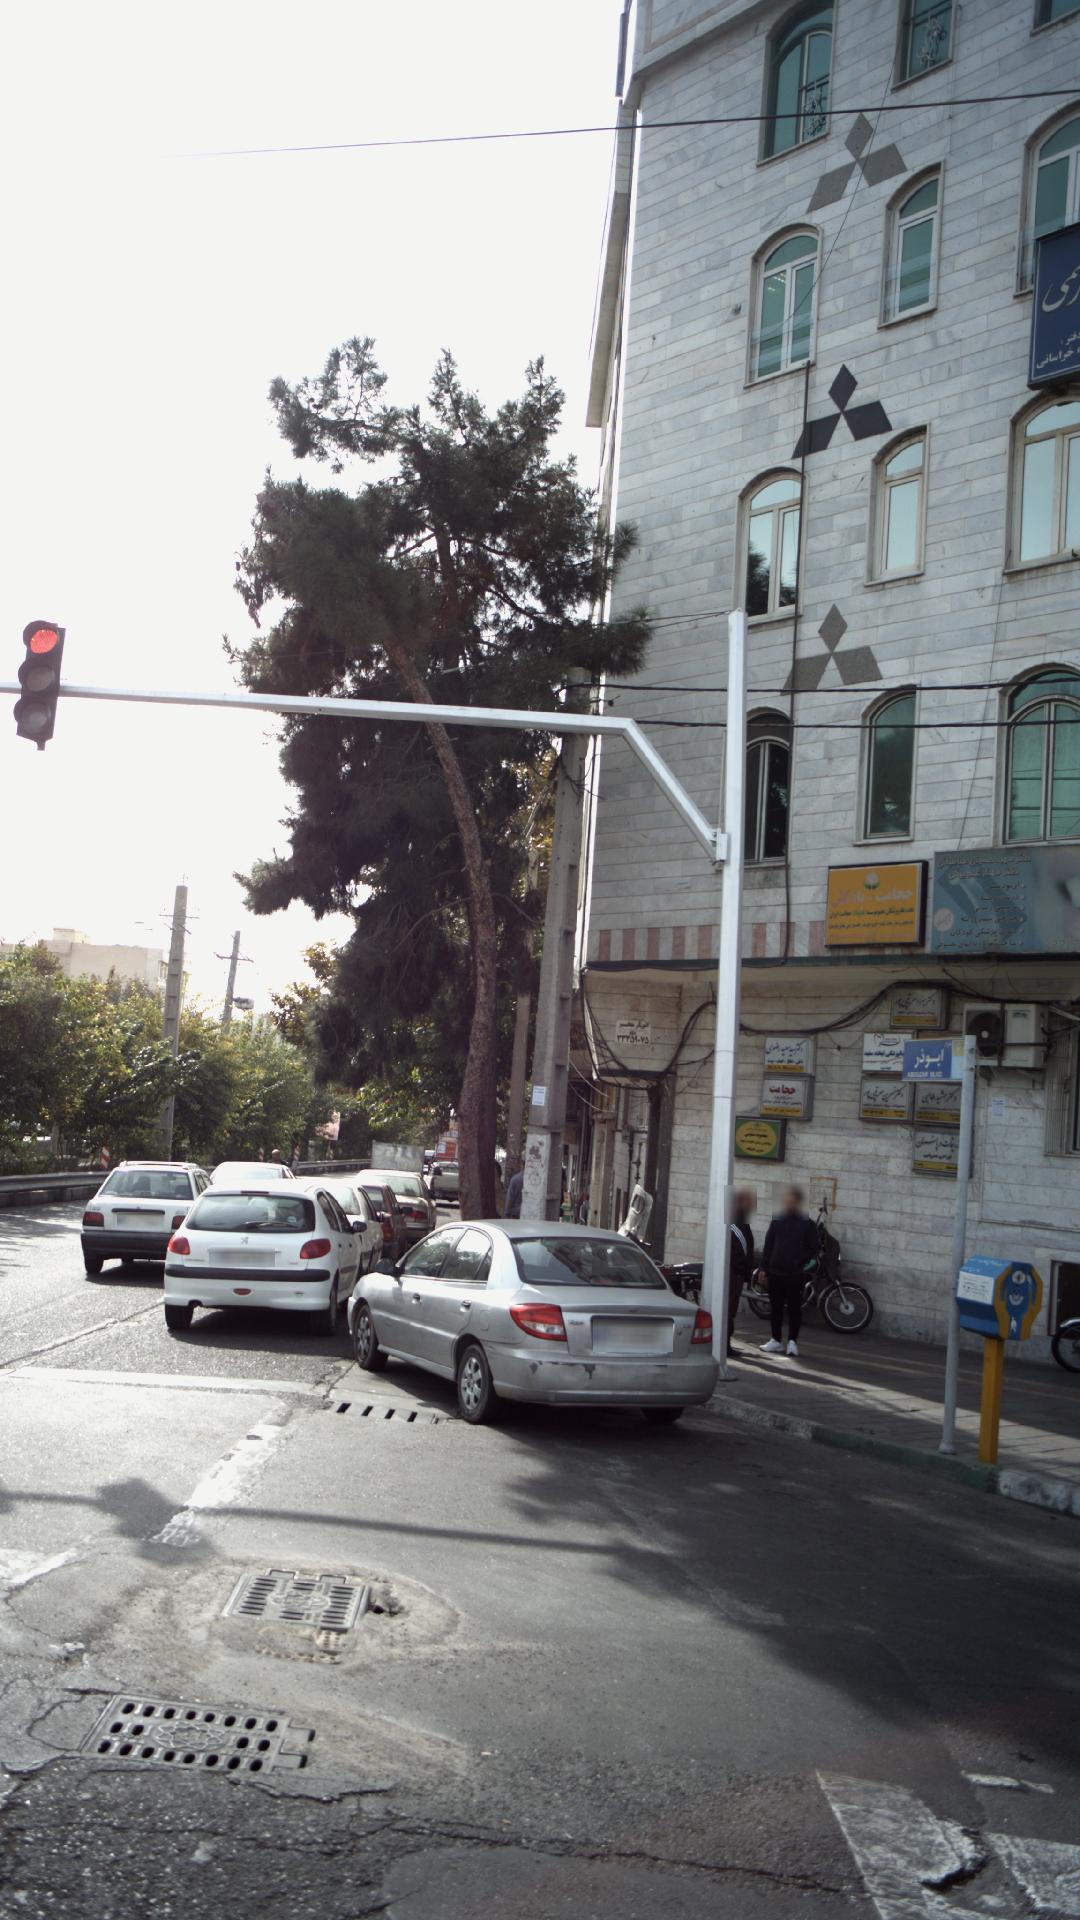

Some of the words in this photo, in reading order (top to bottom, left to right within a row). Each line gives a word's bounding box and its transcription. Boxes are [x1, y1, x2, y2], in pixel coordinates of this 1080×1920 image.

[1036, 346, 1074, 369] خراسانی
[914, 1048, 944, 1069] ابوذر
[769, 1084, 796, 1094] حجامت
